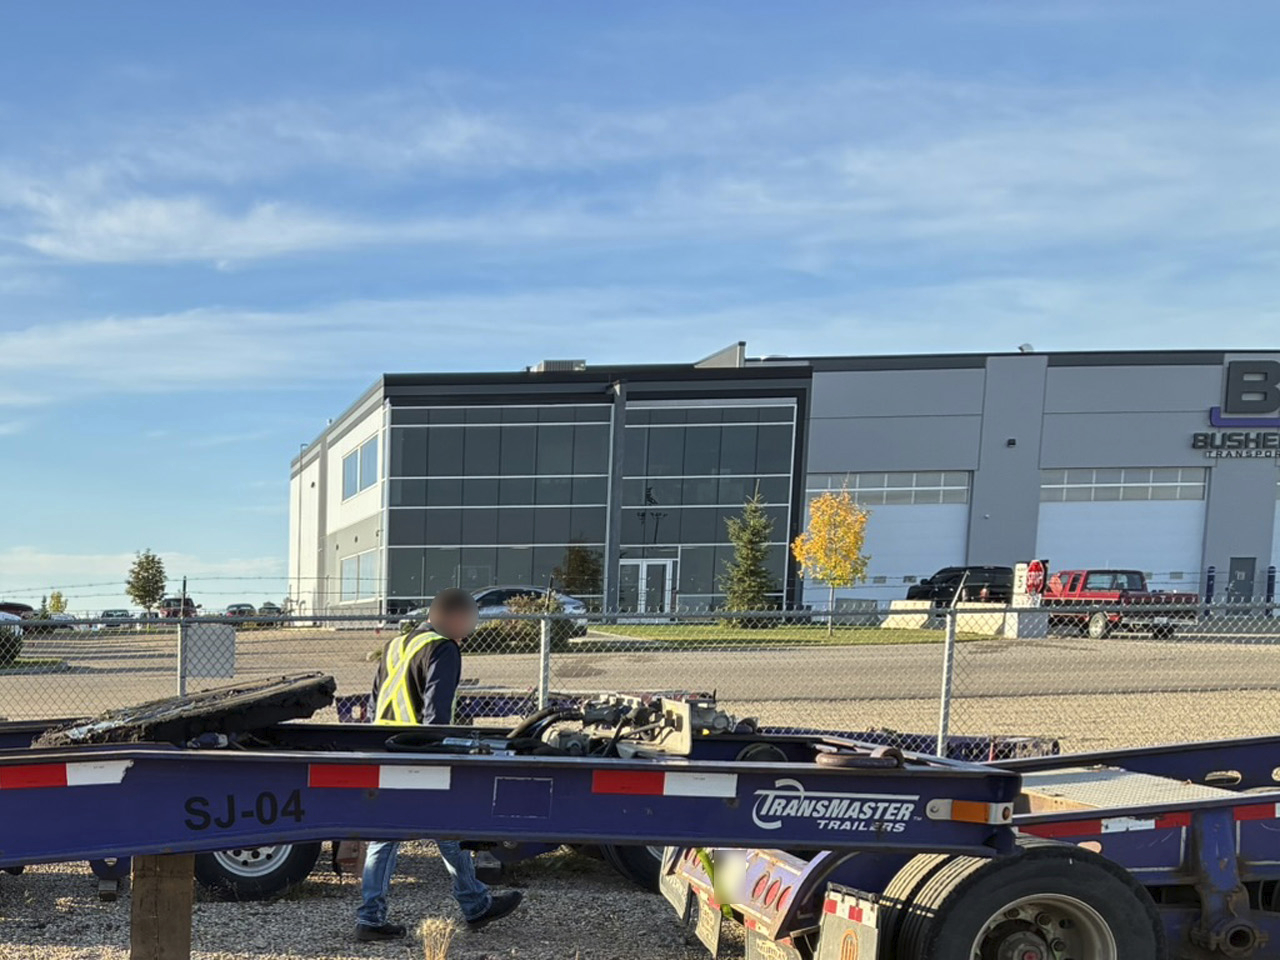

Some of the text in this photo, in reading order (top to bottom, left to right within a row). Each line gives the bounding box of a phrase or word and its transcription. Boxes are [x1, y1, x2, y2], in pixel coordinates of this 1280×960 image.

[1192, 432, 1280, 449] BUSHE
[183, 789, 306, 831] SJ-04
[753, 787, 920, 823] TRANSMASTER
[817, 819, 906, 833] TRAILERS
